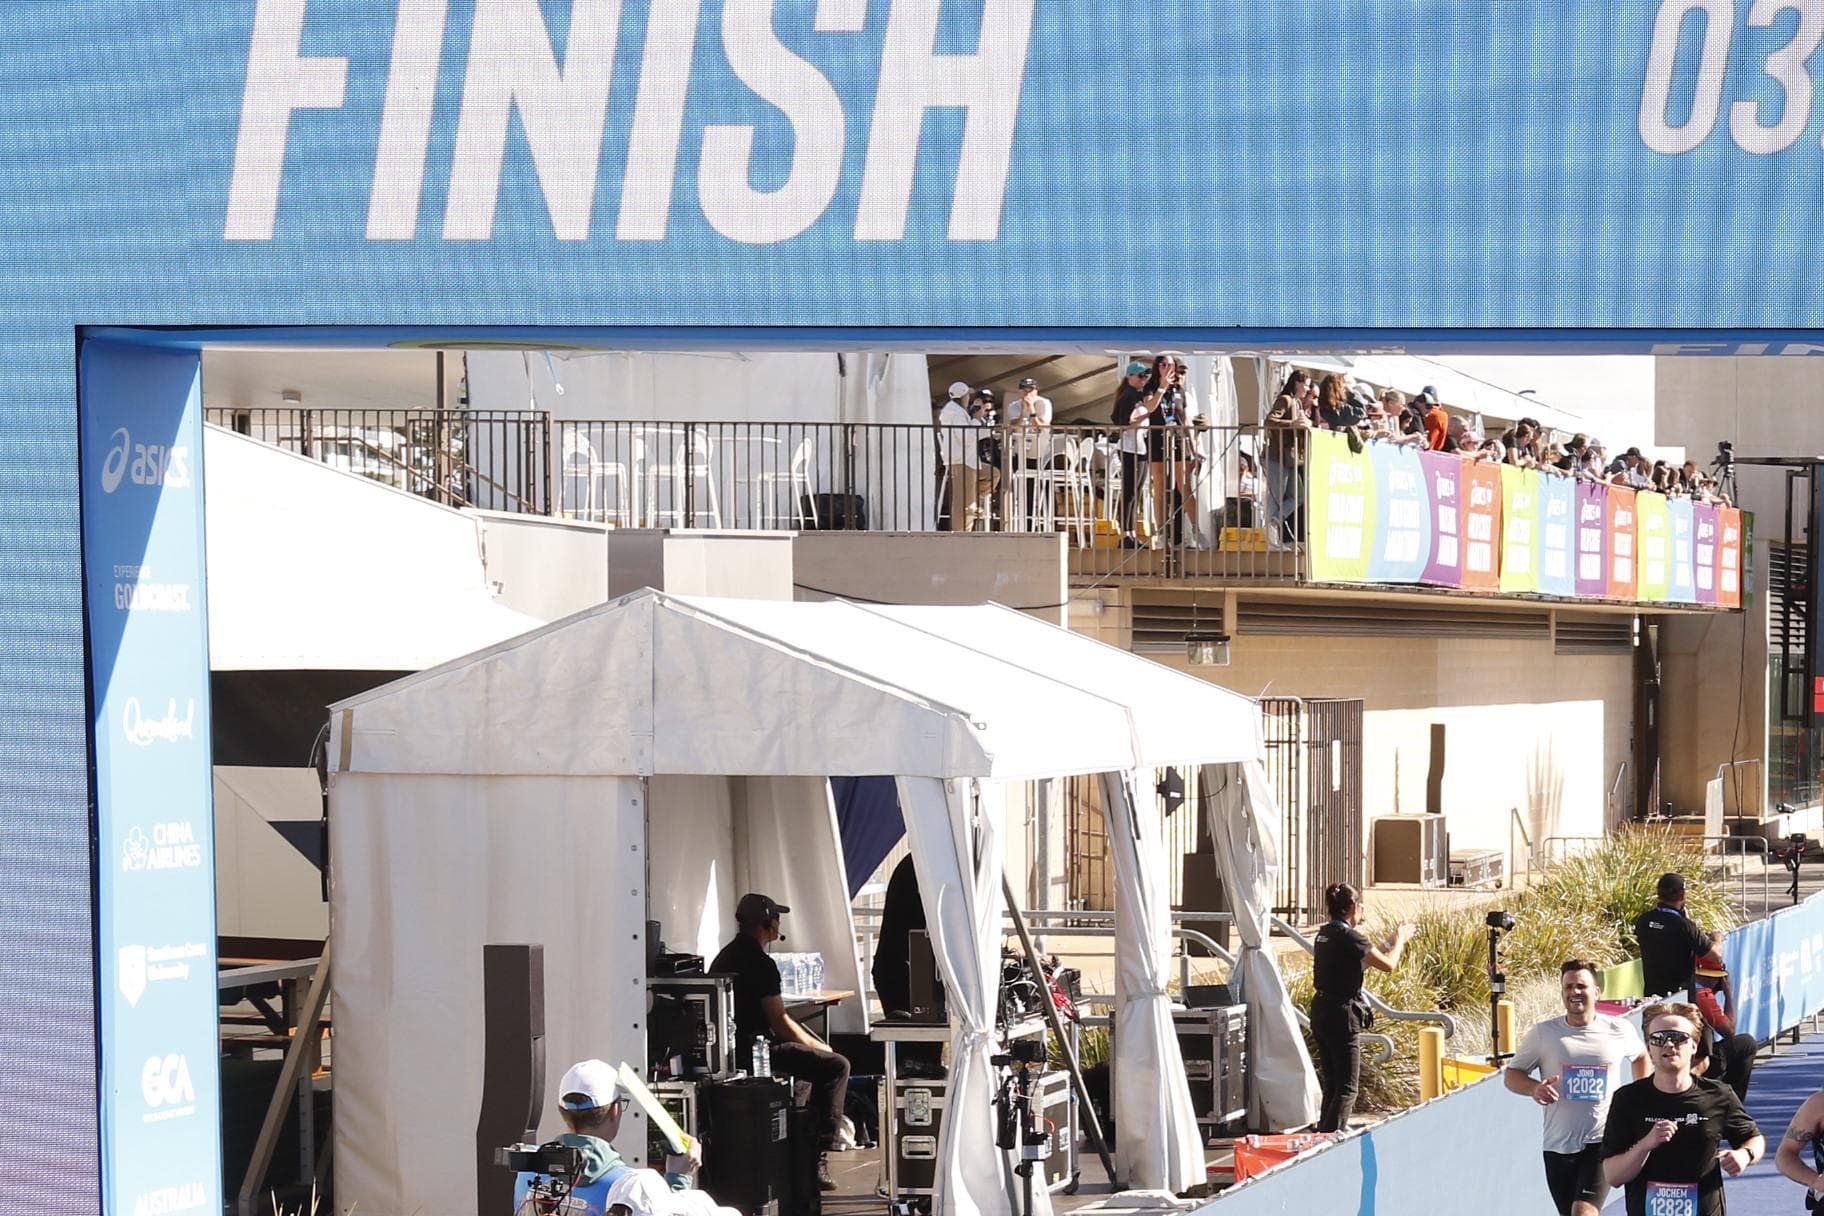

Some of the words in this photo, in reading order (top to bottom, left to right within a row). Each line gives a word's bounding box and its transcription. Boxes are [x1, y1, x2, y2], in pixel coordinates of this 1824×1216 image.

[223, 0, 1035, 244] FINISH
[1566, 1077, 1604, 1094] 12022
[1656, 1187, 1688, 1198] JOCHEM
